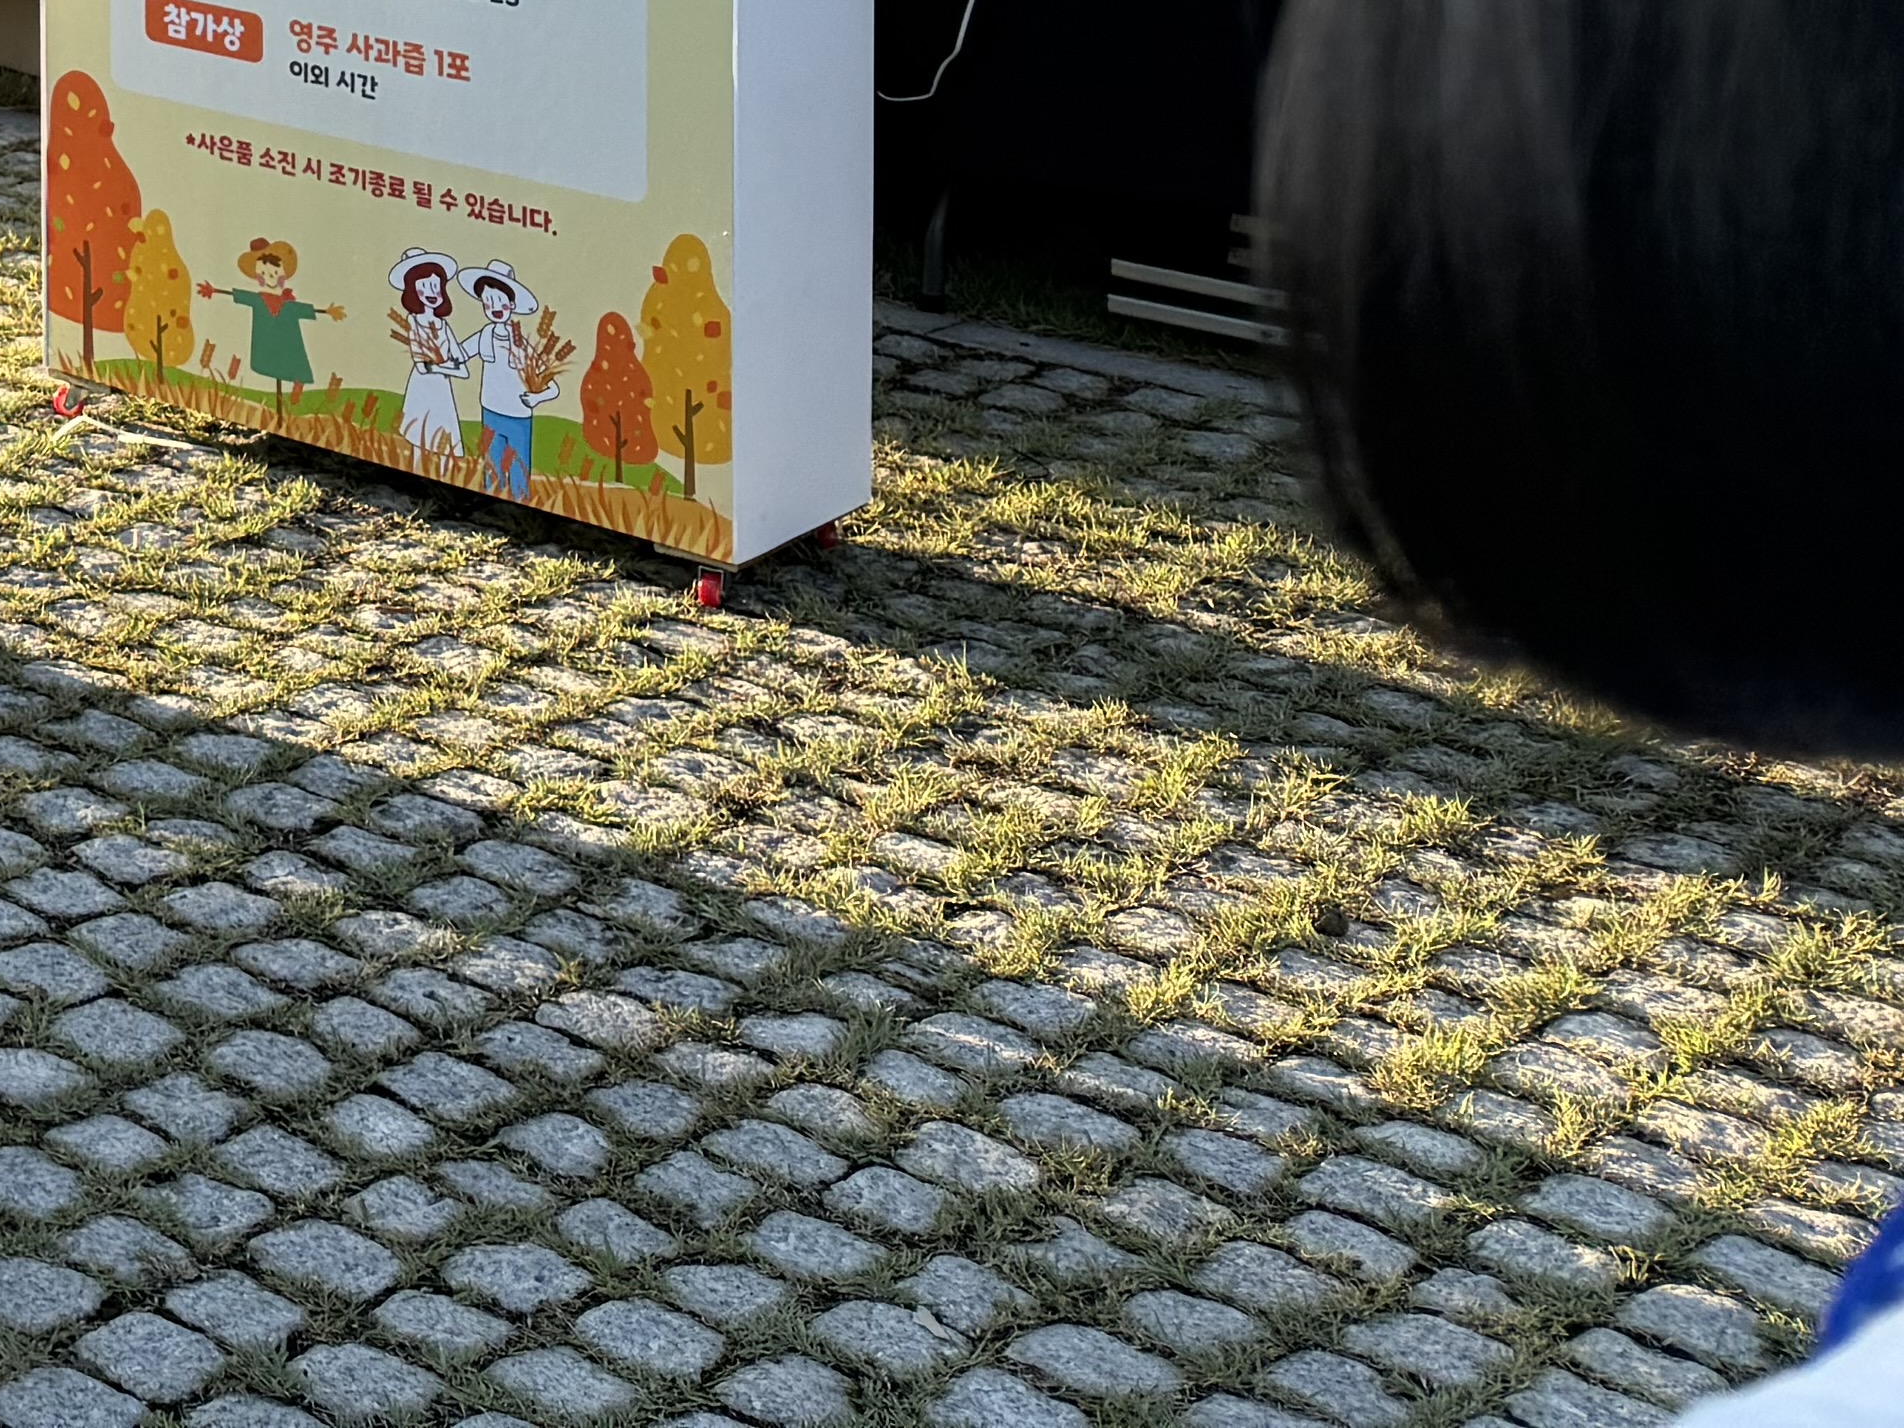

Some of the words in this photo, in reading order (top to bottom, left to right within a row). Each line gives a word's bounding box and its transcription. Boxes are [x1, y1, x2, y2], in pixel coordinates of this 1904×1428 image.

[163, 3, 245, 52] 참가상
[288, 18, 339, 56] 영주
[345, 30, 427, 72] 사과즙
[435, 48, 471, 83] 1포
[289, 61, 330, 89] 이외
[336, 70, 379, 101] 시간
[258, 148, 296, 177] 소진
[302, 157, 322, 183] 시
[328, 163, 407, 202] 조기종료
[412, 181, 433, 211] 될
[439, 189, 459, 213] 수
[464, 193, 559, 238] 있습니다.
